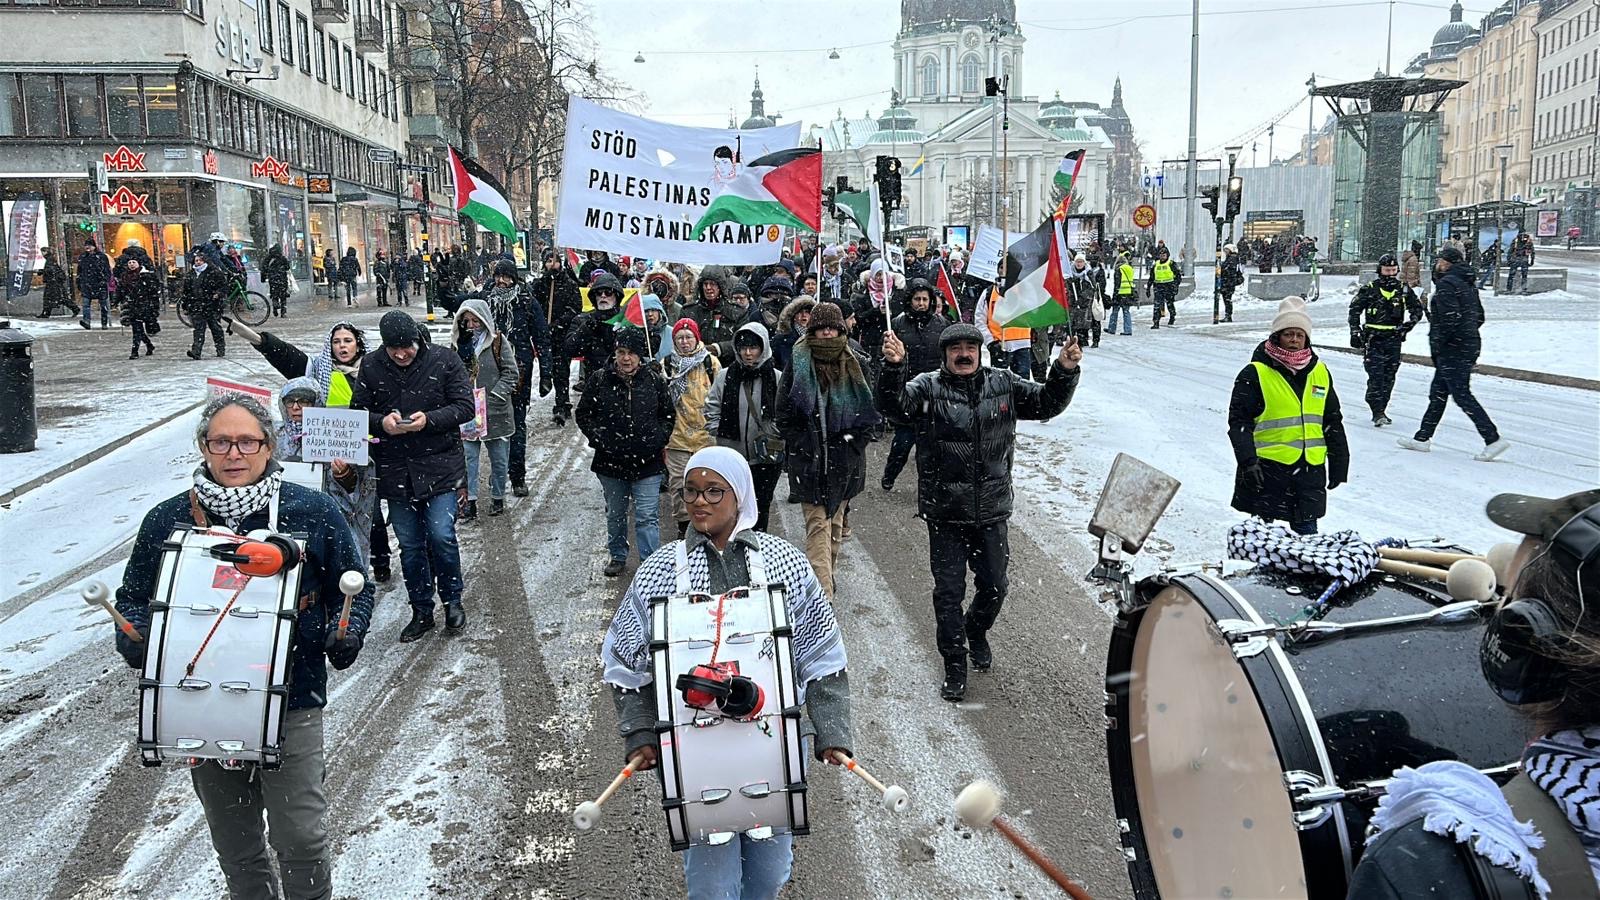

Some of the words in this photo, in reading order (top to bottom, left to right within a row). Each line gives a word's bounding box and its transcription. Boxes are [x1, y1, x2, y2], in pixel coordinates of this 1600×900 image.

[215, 14, 255, 70] SEB
[591, 129, 637, 159] STÖD
[103, 145, 147, 172] MAX
[252, 155, 289, 178] MAX
[100, 185, 151, 215] MAX
[588, 168, 711, 207] PALESTINAS
[306, 418, 320, 426] DET
[348, 421, 360, 429] OCH
[308, 428, 321, 436] DET
[310, 449, 327, 457] MAT
[327, 439, 349, 448] BARNEN
[349, 440, 362, 449] MED
